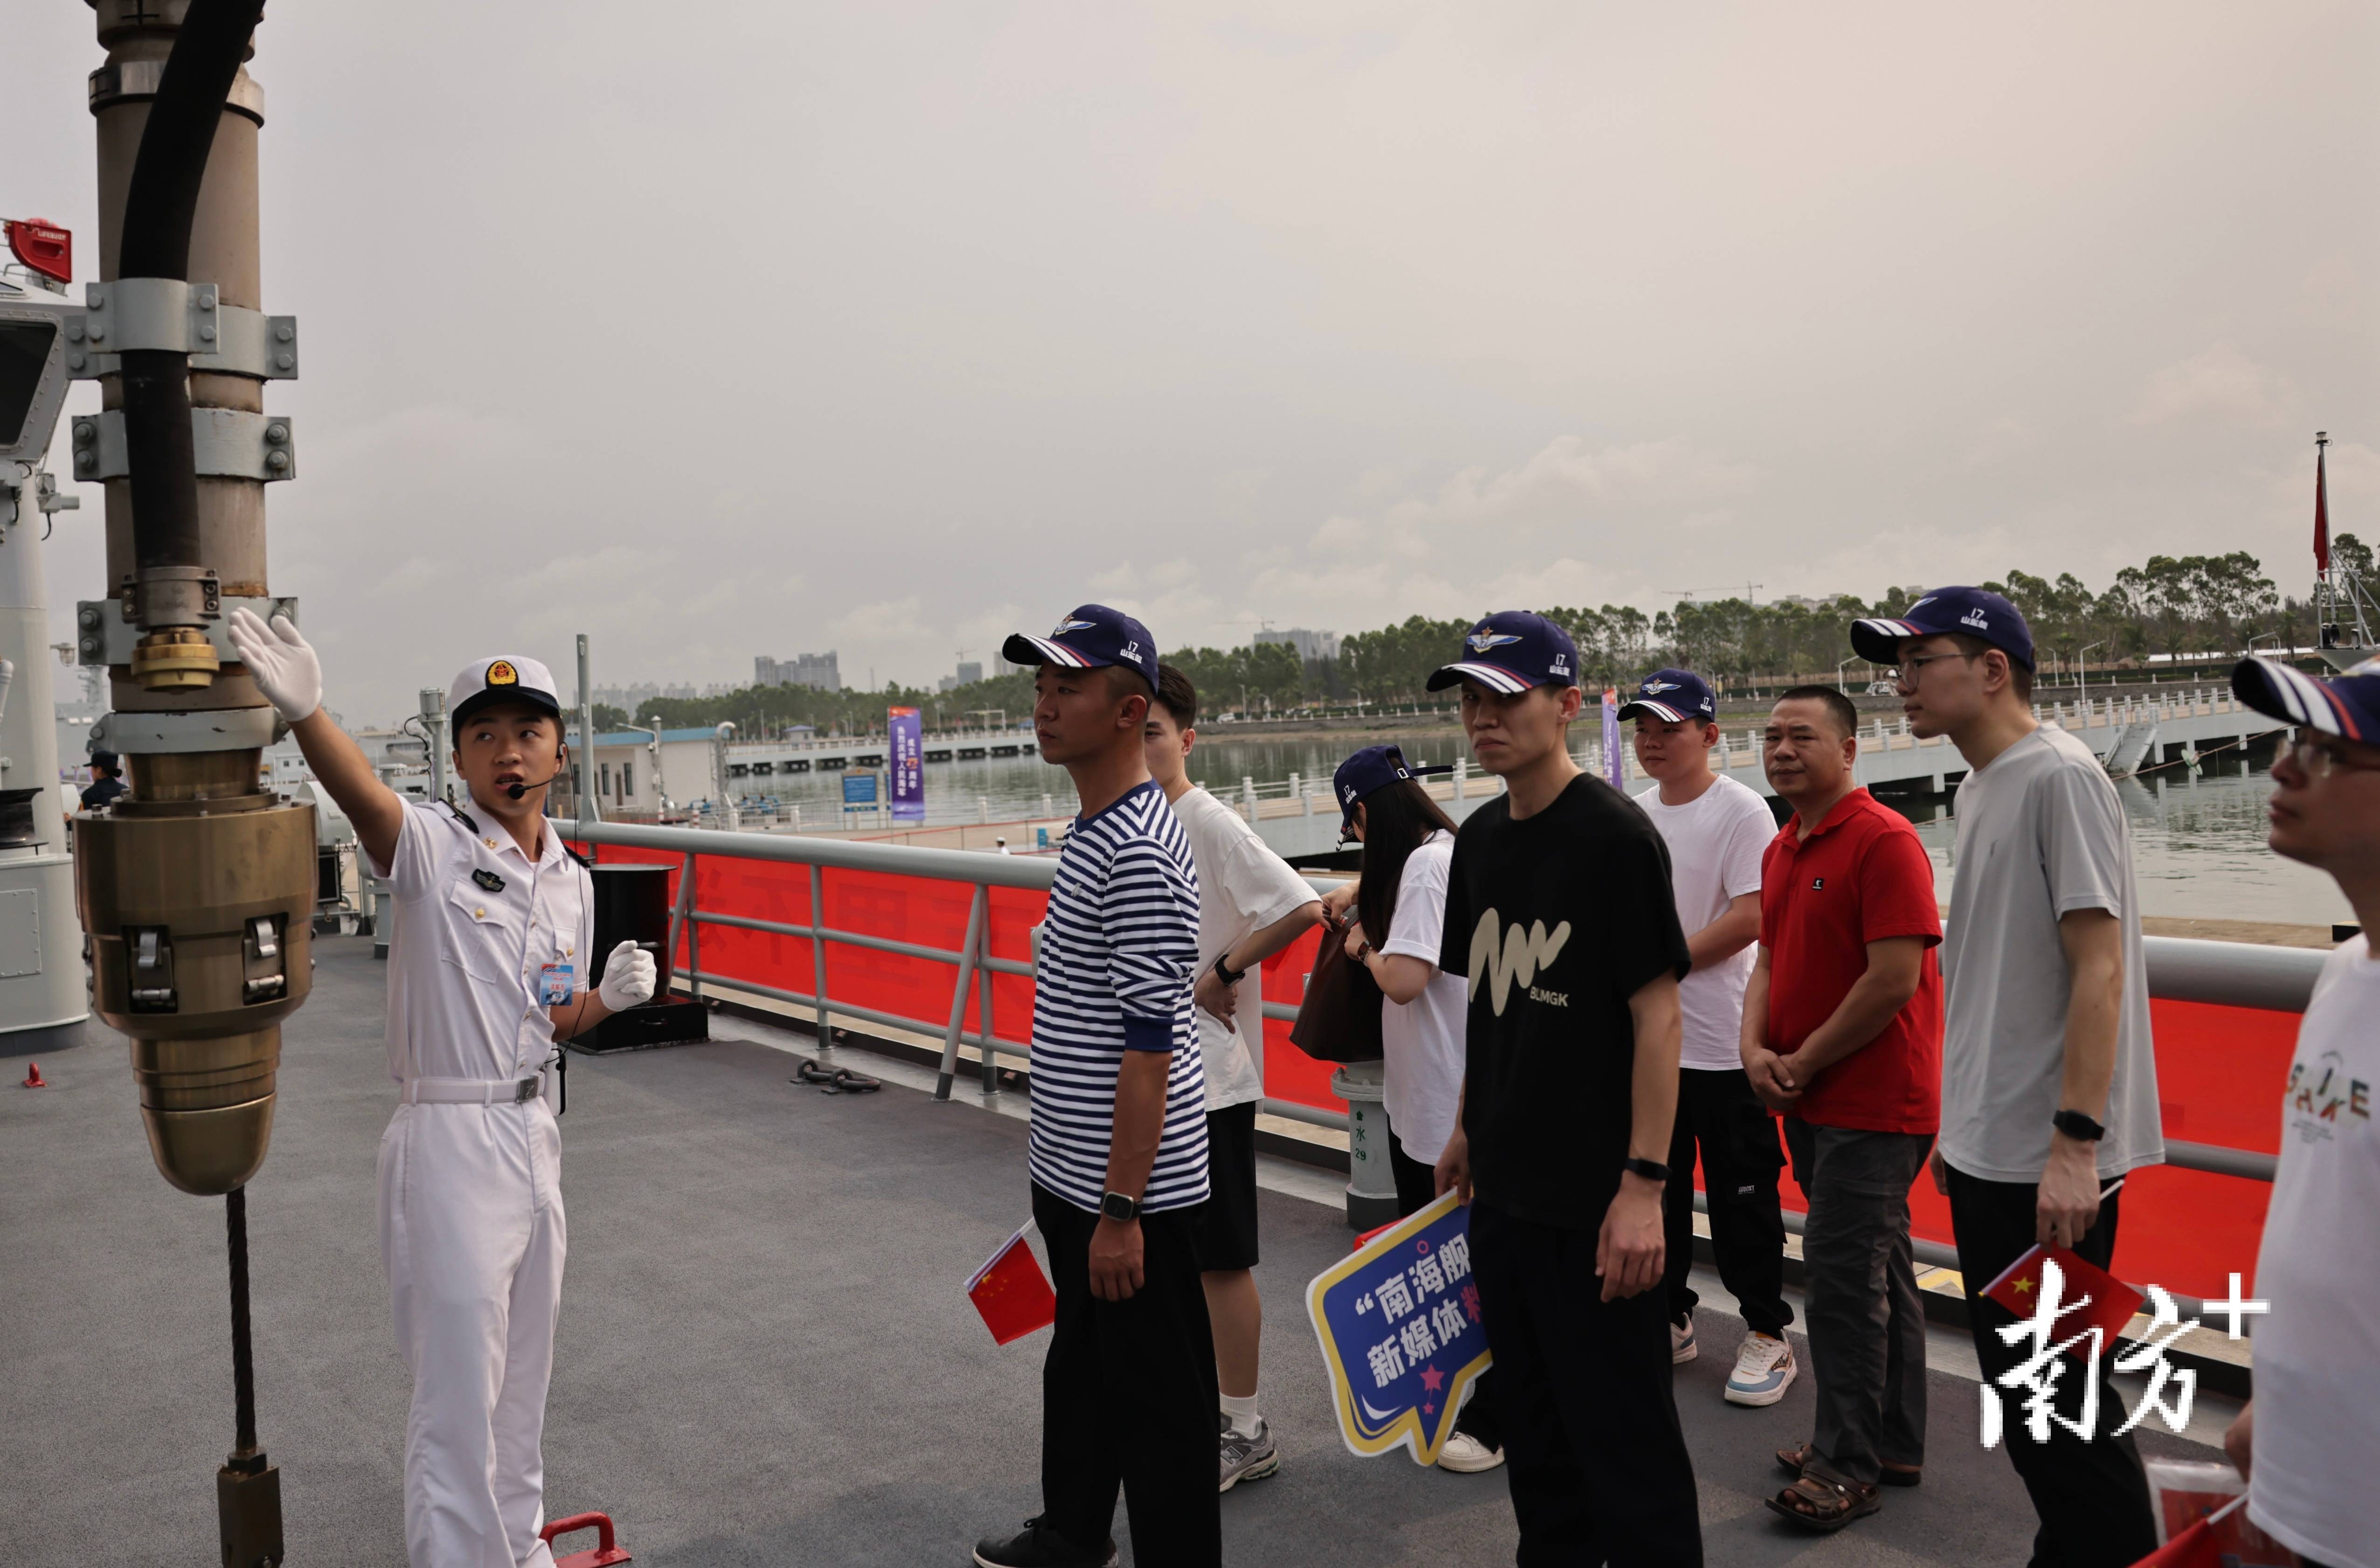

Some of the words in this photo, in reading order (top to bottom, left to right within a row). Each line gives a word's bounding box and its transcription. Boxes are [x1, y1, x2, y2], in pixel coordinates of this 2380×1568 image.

[1971, 607, 1985, 619] 17
[1128, 640, 1138, 652] 17
[1555, 653, 1566, 666] 17
[1704, 696, 1709, 705] 17
[897, 726, 907, 797] 热烈庆祝人民海军
[1344, 784, 1350, 796] 17
[1529, 985, 1569, 1007] BLMGK
[1356, 1125, 1366, 1142] 水
[1355, 1148, 1366, 1161] 29
